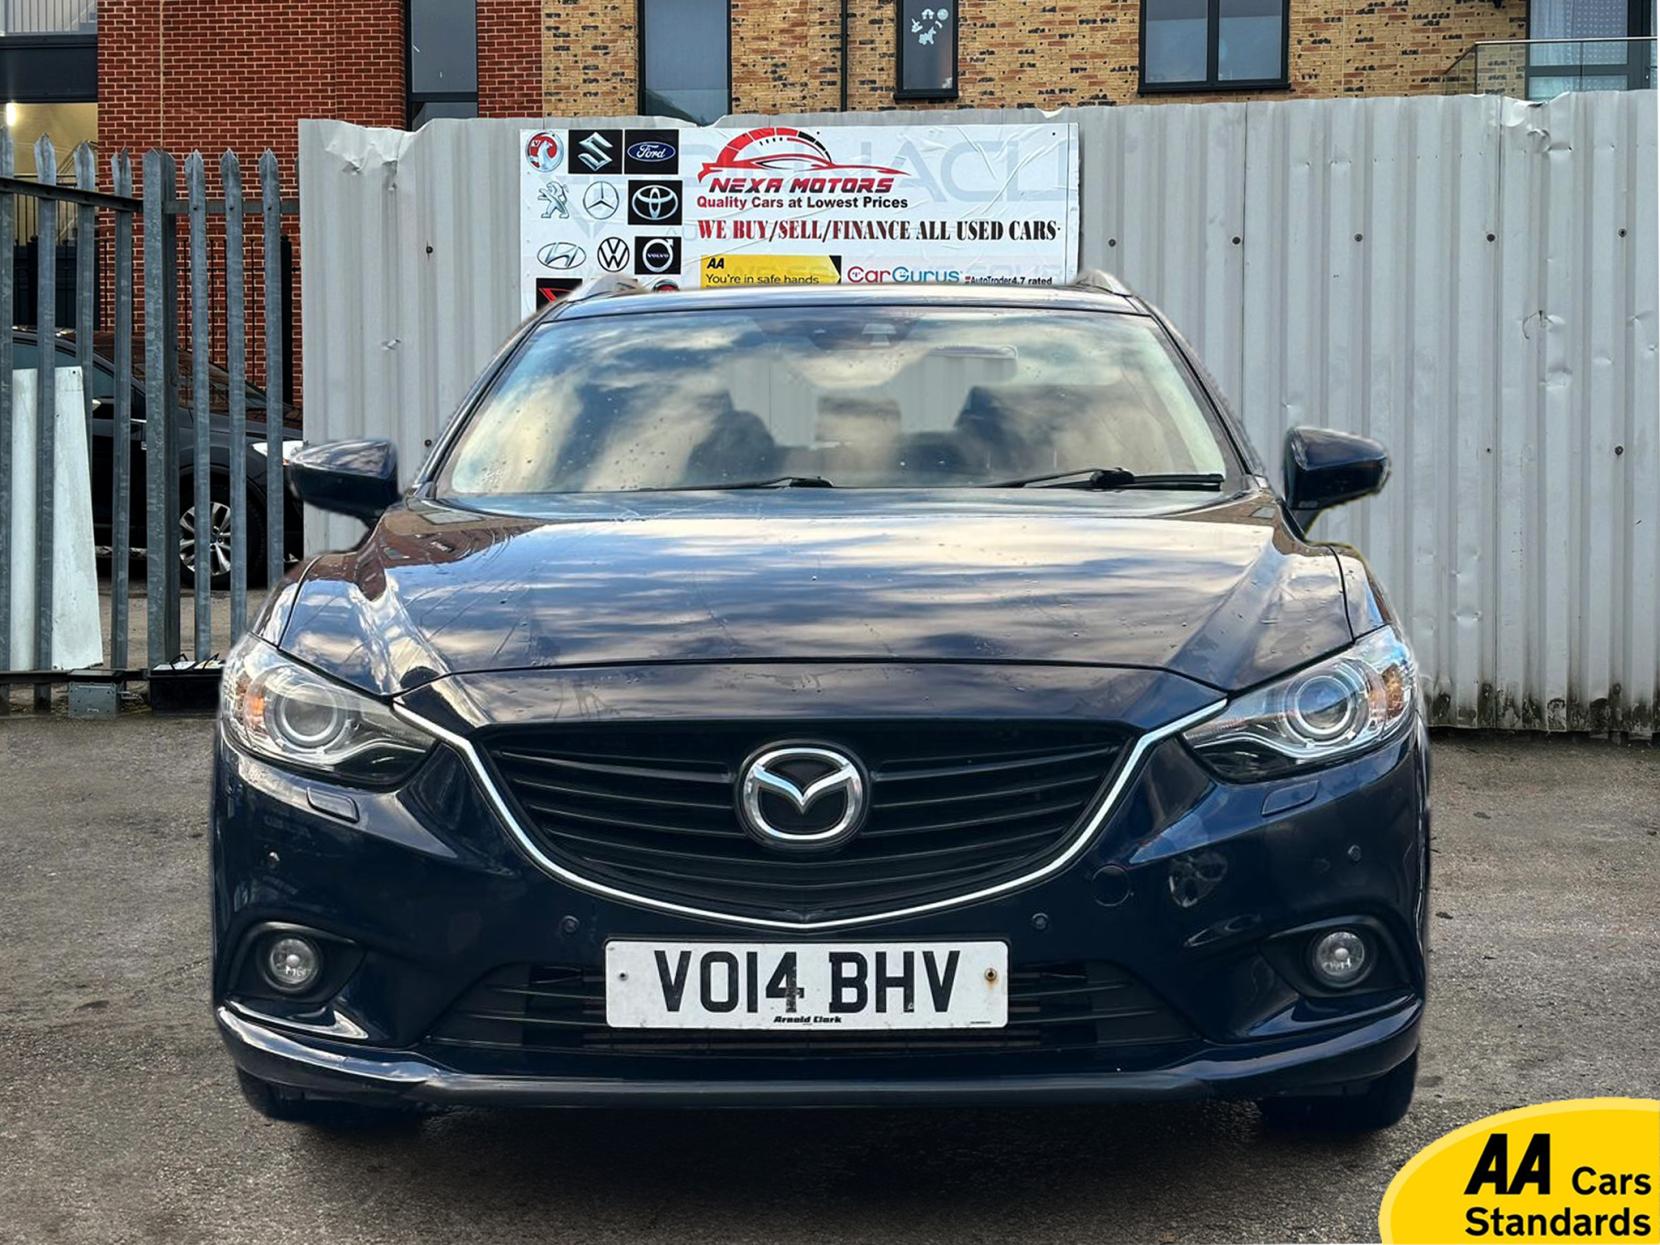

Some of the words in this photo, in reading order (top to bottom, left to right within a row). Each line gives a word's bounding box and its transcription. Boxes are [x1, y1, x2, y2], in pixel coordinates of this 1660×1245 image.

[636, 144, 666, 158] Ford
[709, 178, 783, 193] NEXA
[789, 178, 894, 193] MOTORS
[697, 196, 747, 210] Quality
[751, 196, 784, 208] Cars
[788, 197, 803, 208] at
[807, 196, 858, 208] Lowest
[863, 196, 908, 208] Prices
[698, 220, 727, 239] WE
[917, 221, 950, 240] ALL
[956, 221, 1004, 240] USED
[706, 258, 725, 269] AA
[706, 274, 741, 284] You're
[744, 274, 754, 284] in
[757, 274, 781, 284] safe
[784, 274, 819, 284] hands
[847, 266, 960, 283] CarGurus
[1028, 277, 1053, 285] rated
[654, 950, 804, 1013] VO14
[829, 950, 961, 1013] BHV
